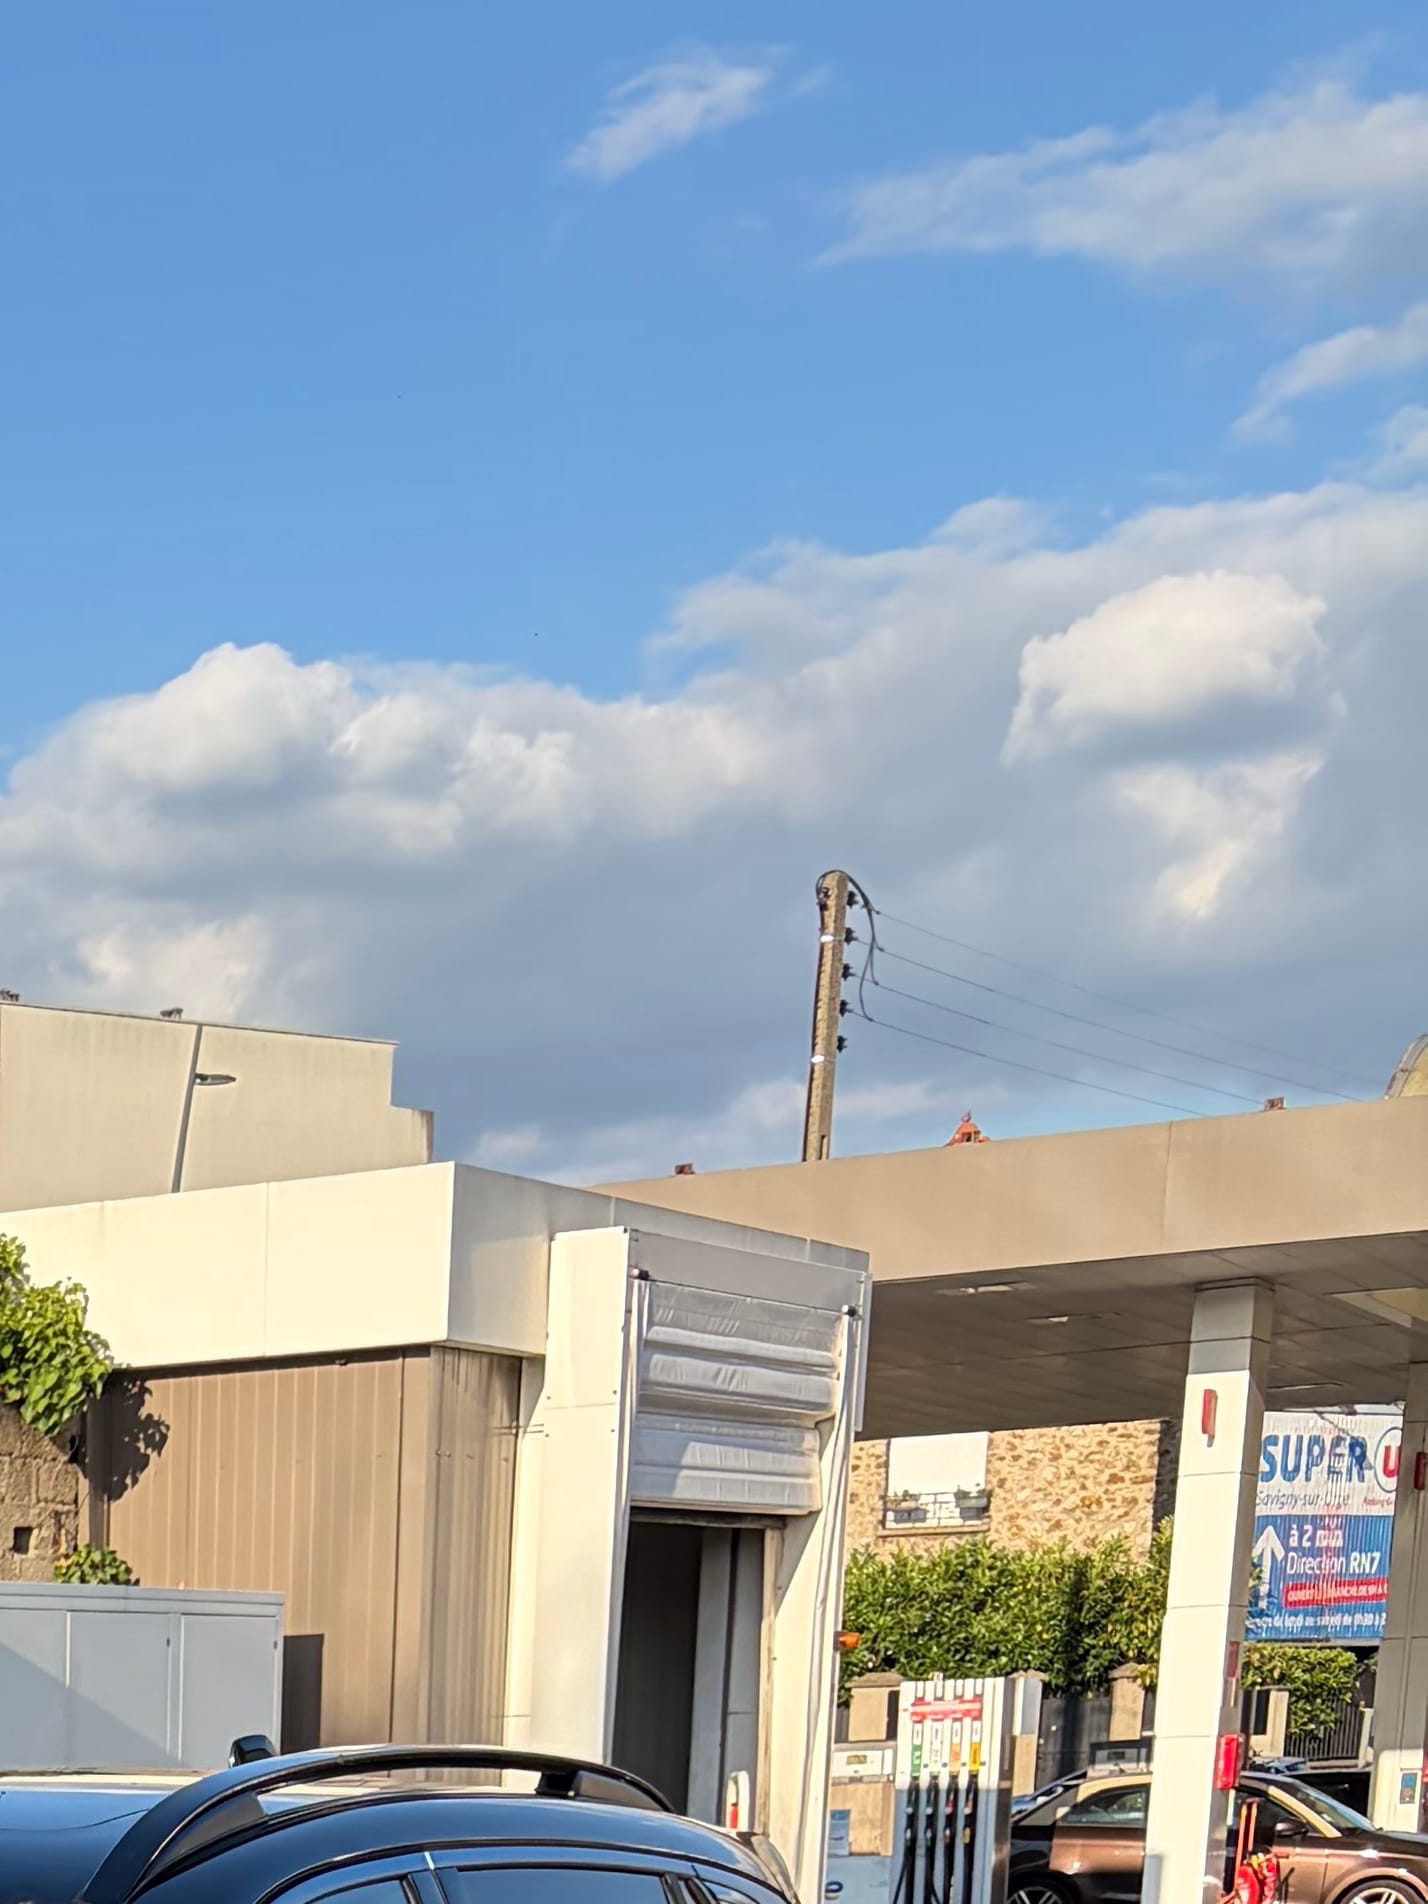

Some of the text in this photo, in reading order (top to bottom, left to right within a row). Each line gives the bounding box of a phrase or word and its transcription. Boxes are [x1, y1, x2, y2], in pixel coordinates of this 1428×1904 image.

[1259, 1434, 1402, 1483] SUPER U
[1302, 1525, 1313, 1547] 2
[1286, 1551, 1381, 1575] Direction RN7
